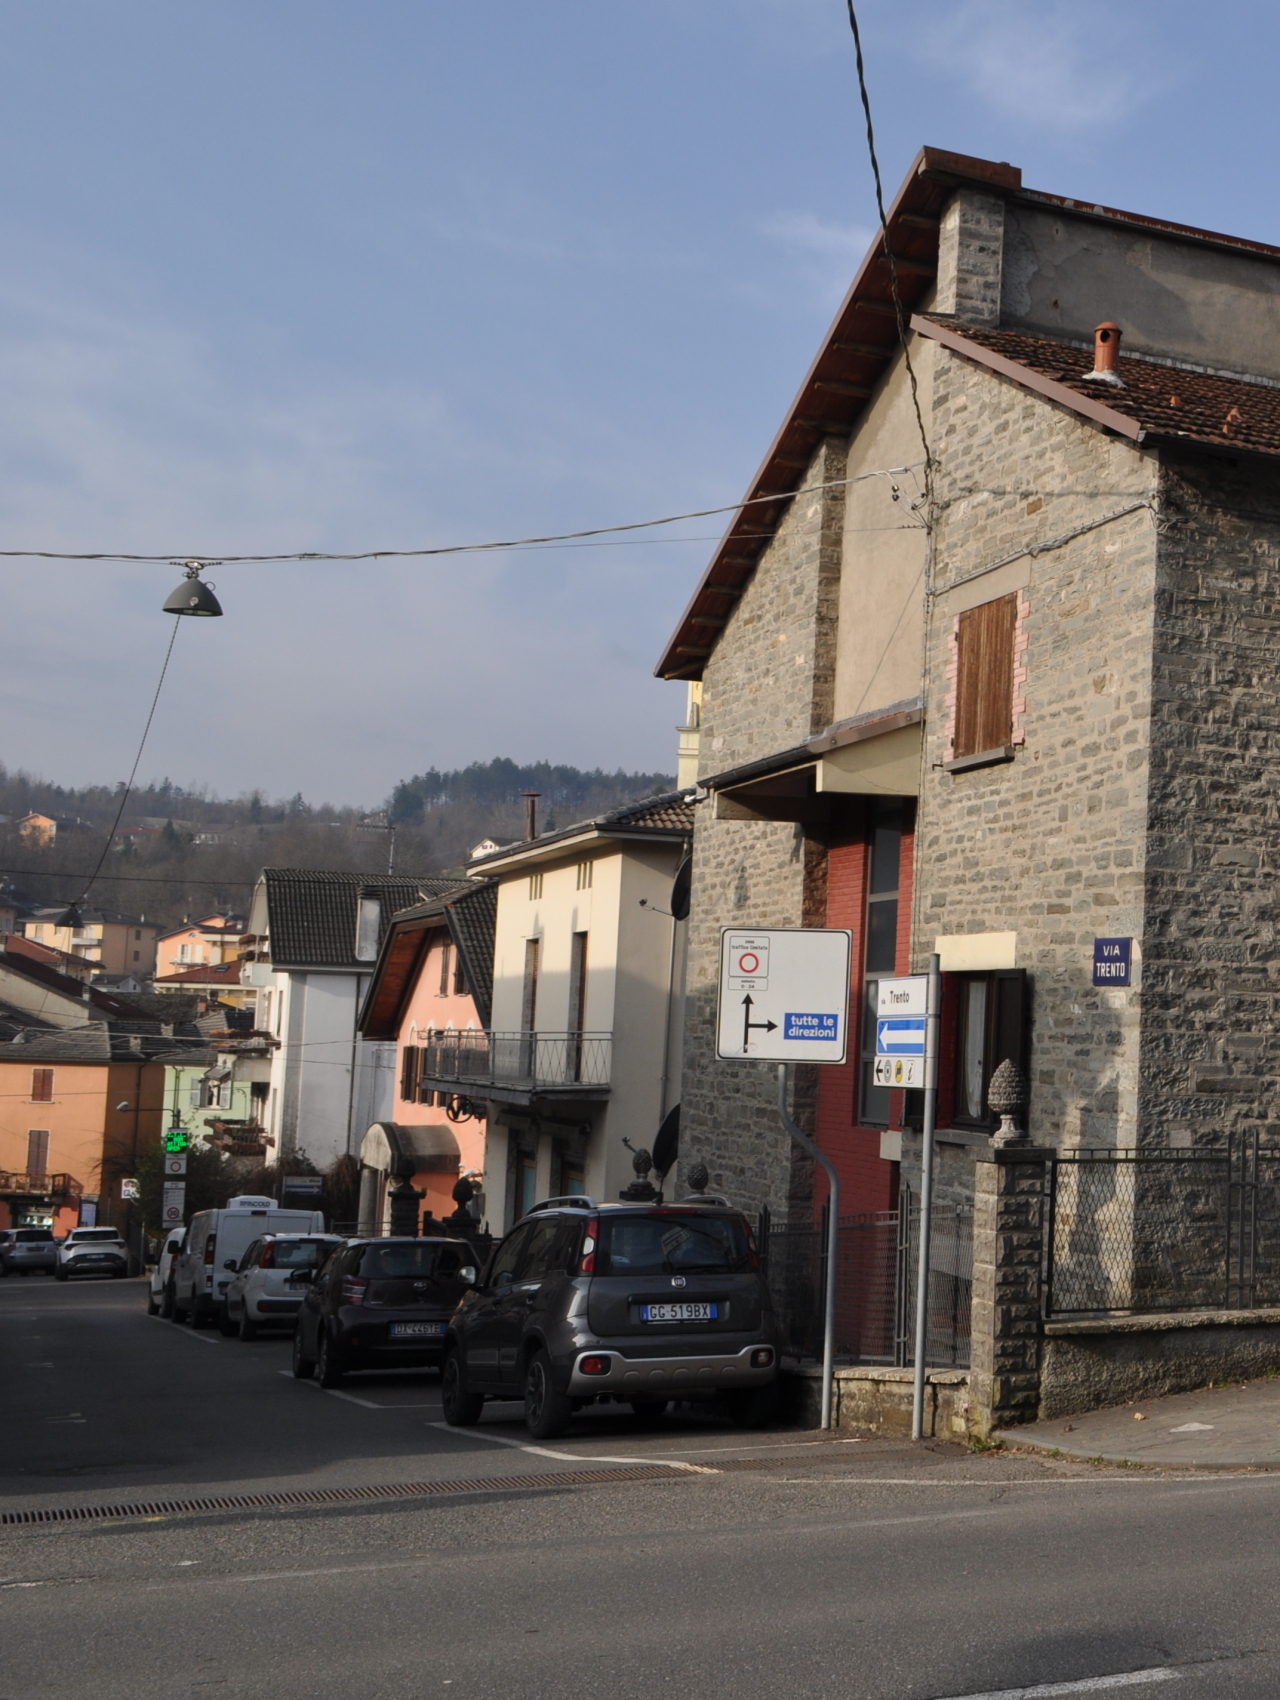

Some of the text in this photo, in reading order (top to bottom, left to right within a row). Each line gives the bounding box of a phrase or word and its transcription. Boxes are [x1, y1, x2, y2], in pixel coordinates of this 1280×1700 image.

[1103, 945, 1120, 956] VIA
[1096, 962, 1125, 977] TRENTO
[890, 990, 910, 1004] Trento
[791, 1015, 834, 1026] tutte le
[788, 1026, 835, 1037] direzioni
